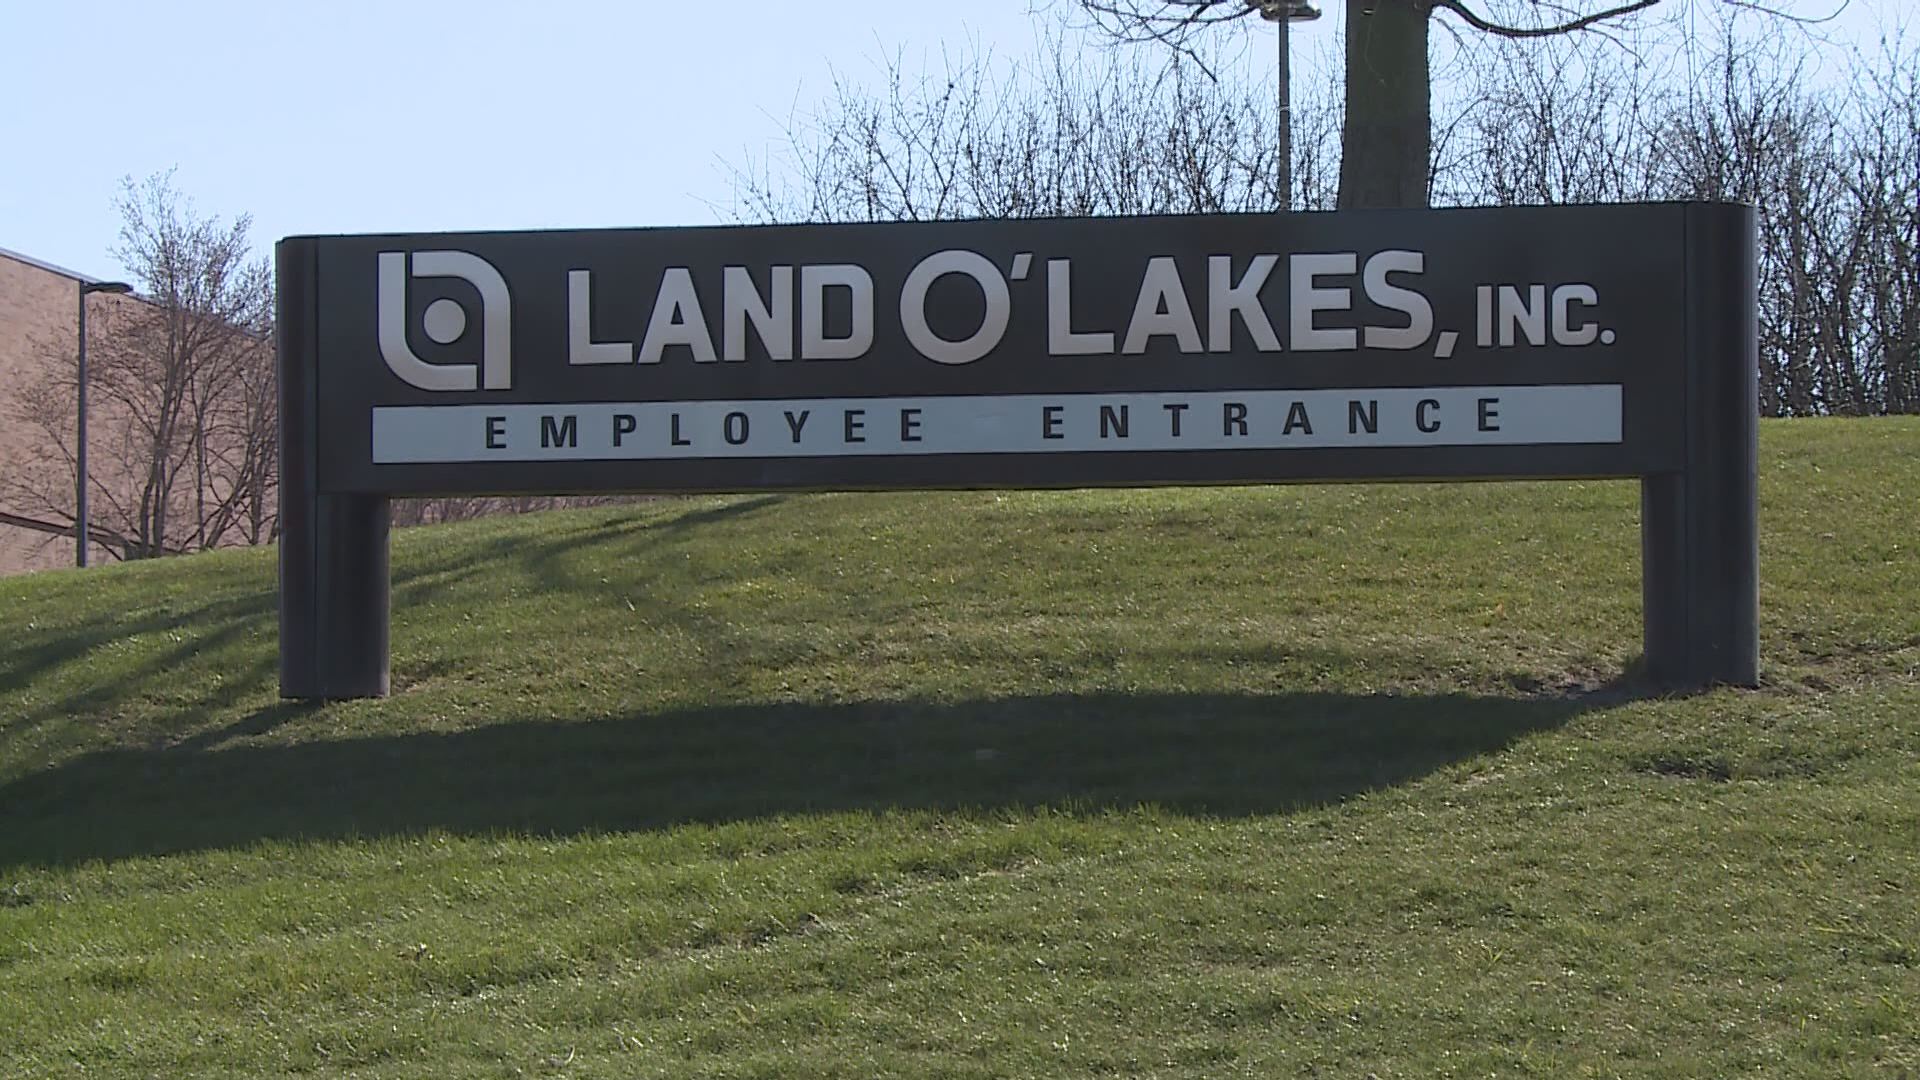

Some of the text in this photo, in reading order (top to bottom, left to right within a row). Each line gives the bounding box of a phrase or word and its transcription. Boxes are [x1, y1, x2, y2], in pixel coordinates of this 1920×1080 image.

[568, 264, 874, 364] LAND
[1477, 284, 1615, 347] INC.
[486, 397, 1501, 449] EMPLOYEE ENTRANCE
